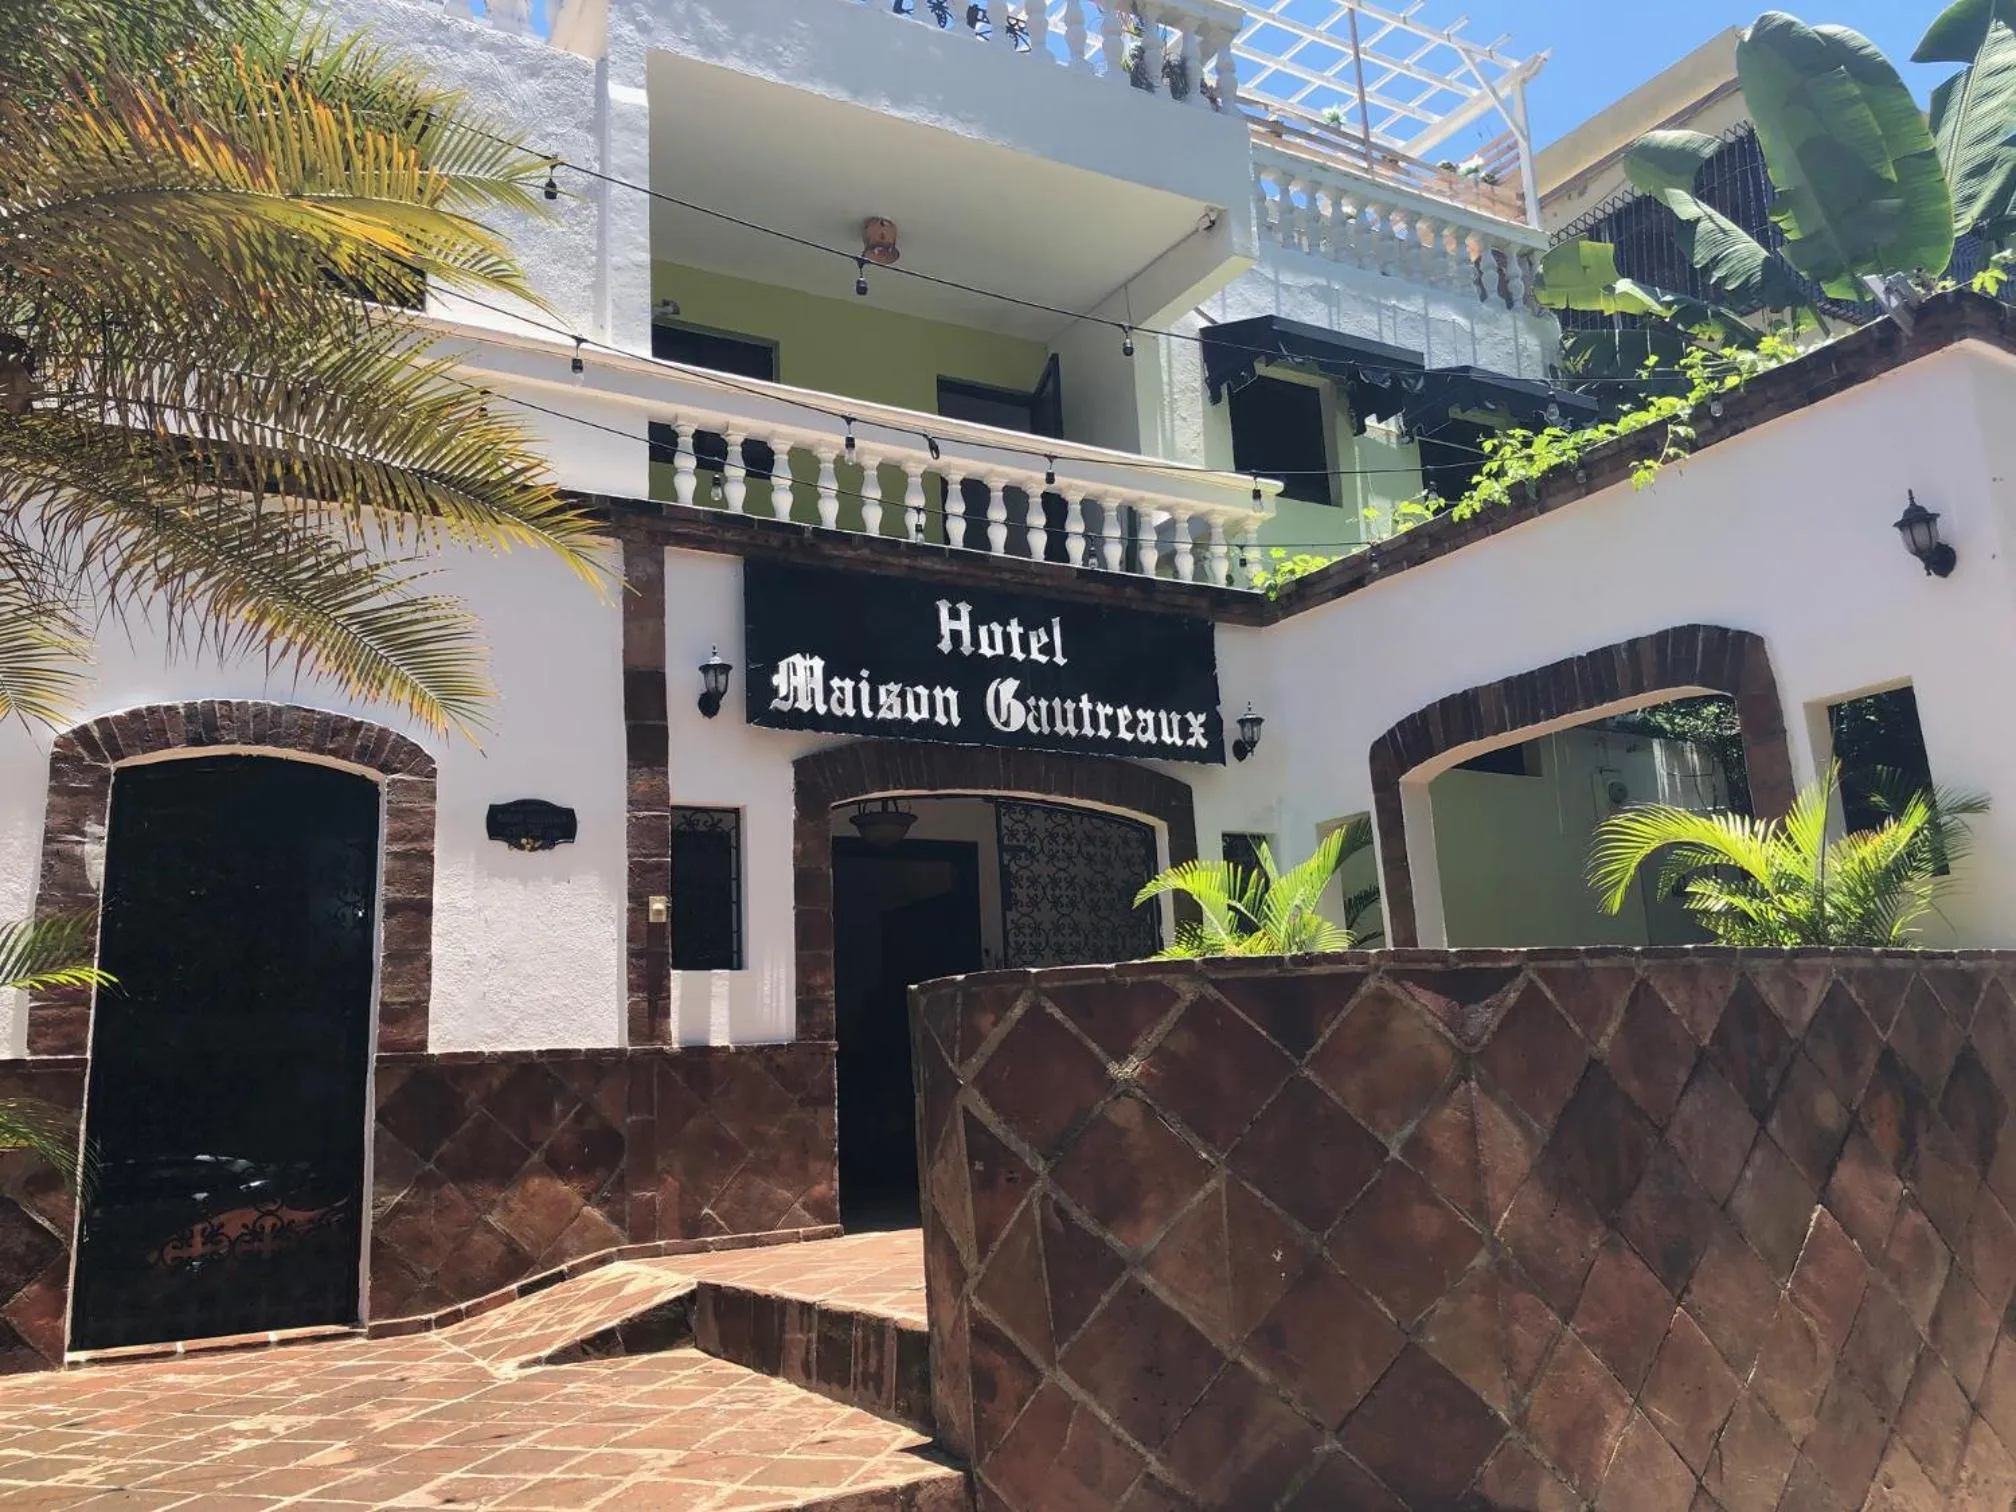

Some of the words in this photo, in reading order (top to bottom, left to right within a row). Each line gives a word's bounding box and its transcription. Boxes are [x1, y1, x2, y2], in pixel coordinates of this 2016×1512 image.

[935, 599, 1068, 667] Hotel
[769, 652, 962, 727] Maison
[985, 677, 1209, 749] Gautreaux
